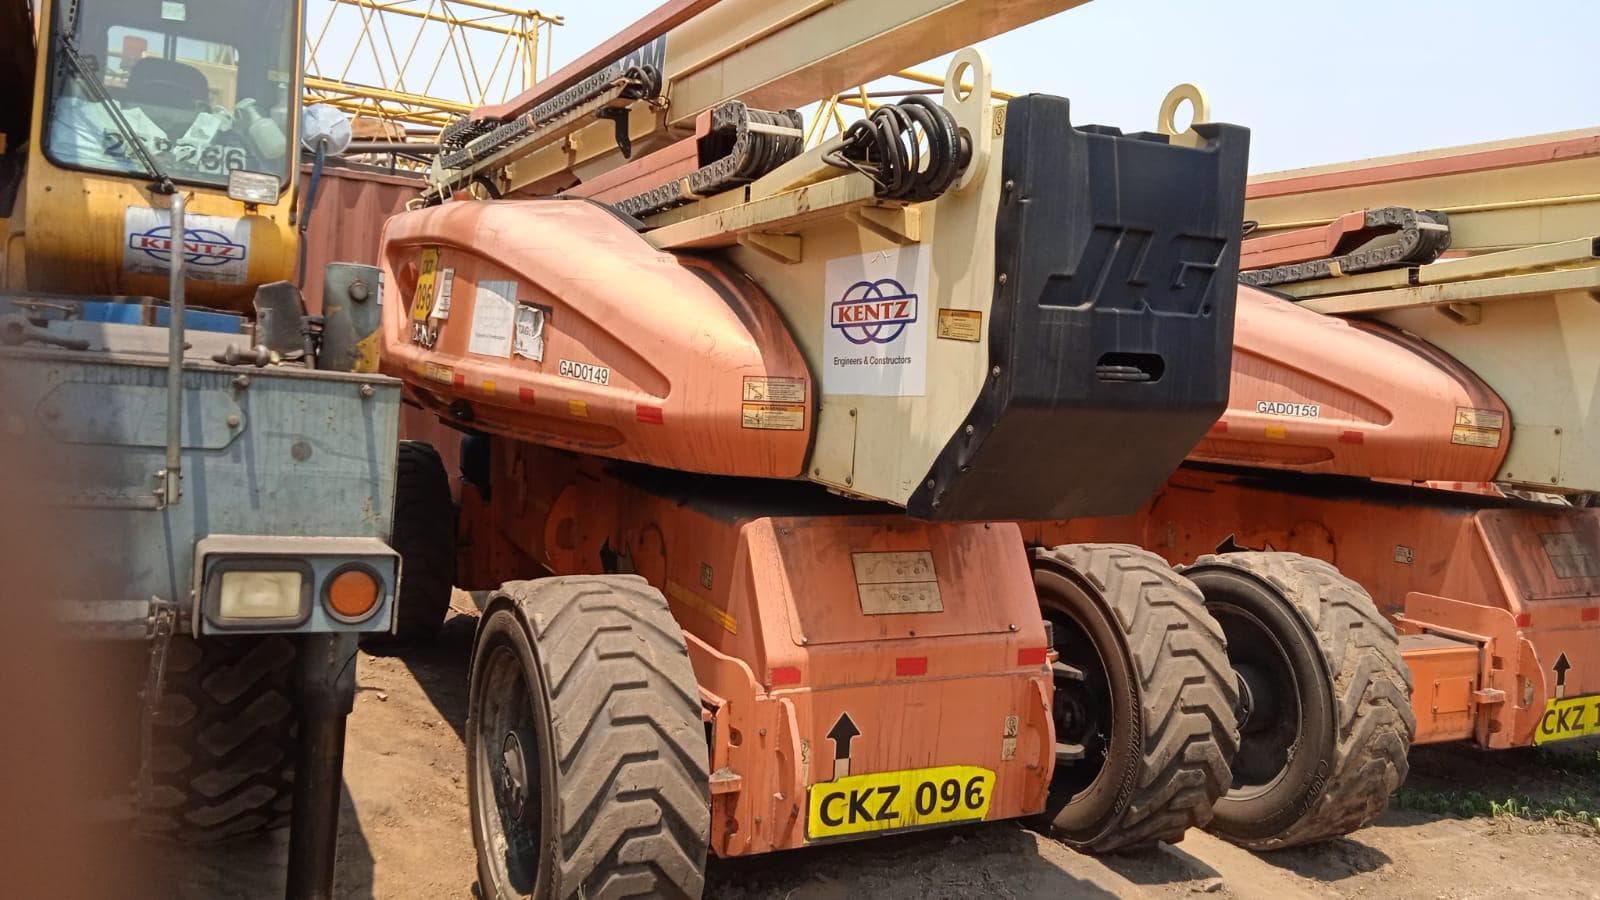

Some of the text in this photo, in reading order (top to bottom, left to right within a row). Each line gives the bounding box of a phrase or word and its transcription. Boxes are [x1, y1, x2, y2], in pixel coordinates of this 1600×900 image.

[1038, 223, 1228, 317] JLG
[838, 301, 910, 323] KENTZ
[559, 360, 608, 384] GAD0149
[833, 355, 911, 368] Engineers & Constructors
[1257, 401, 1318, 417] GAD0153
[1541, 704, 1585, 735] CKZ
[820, 776, 984, 827] CKZ 096
